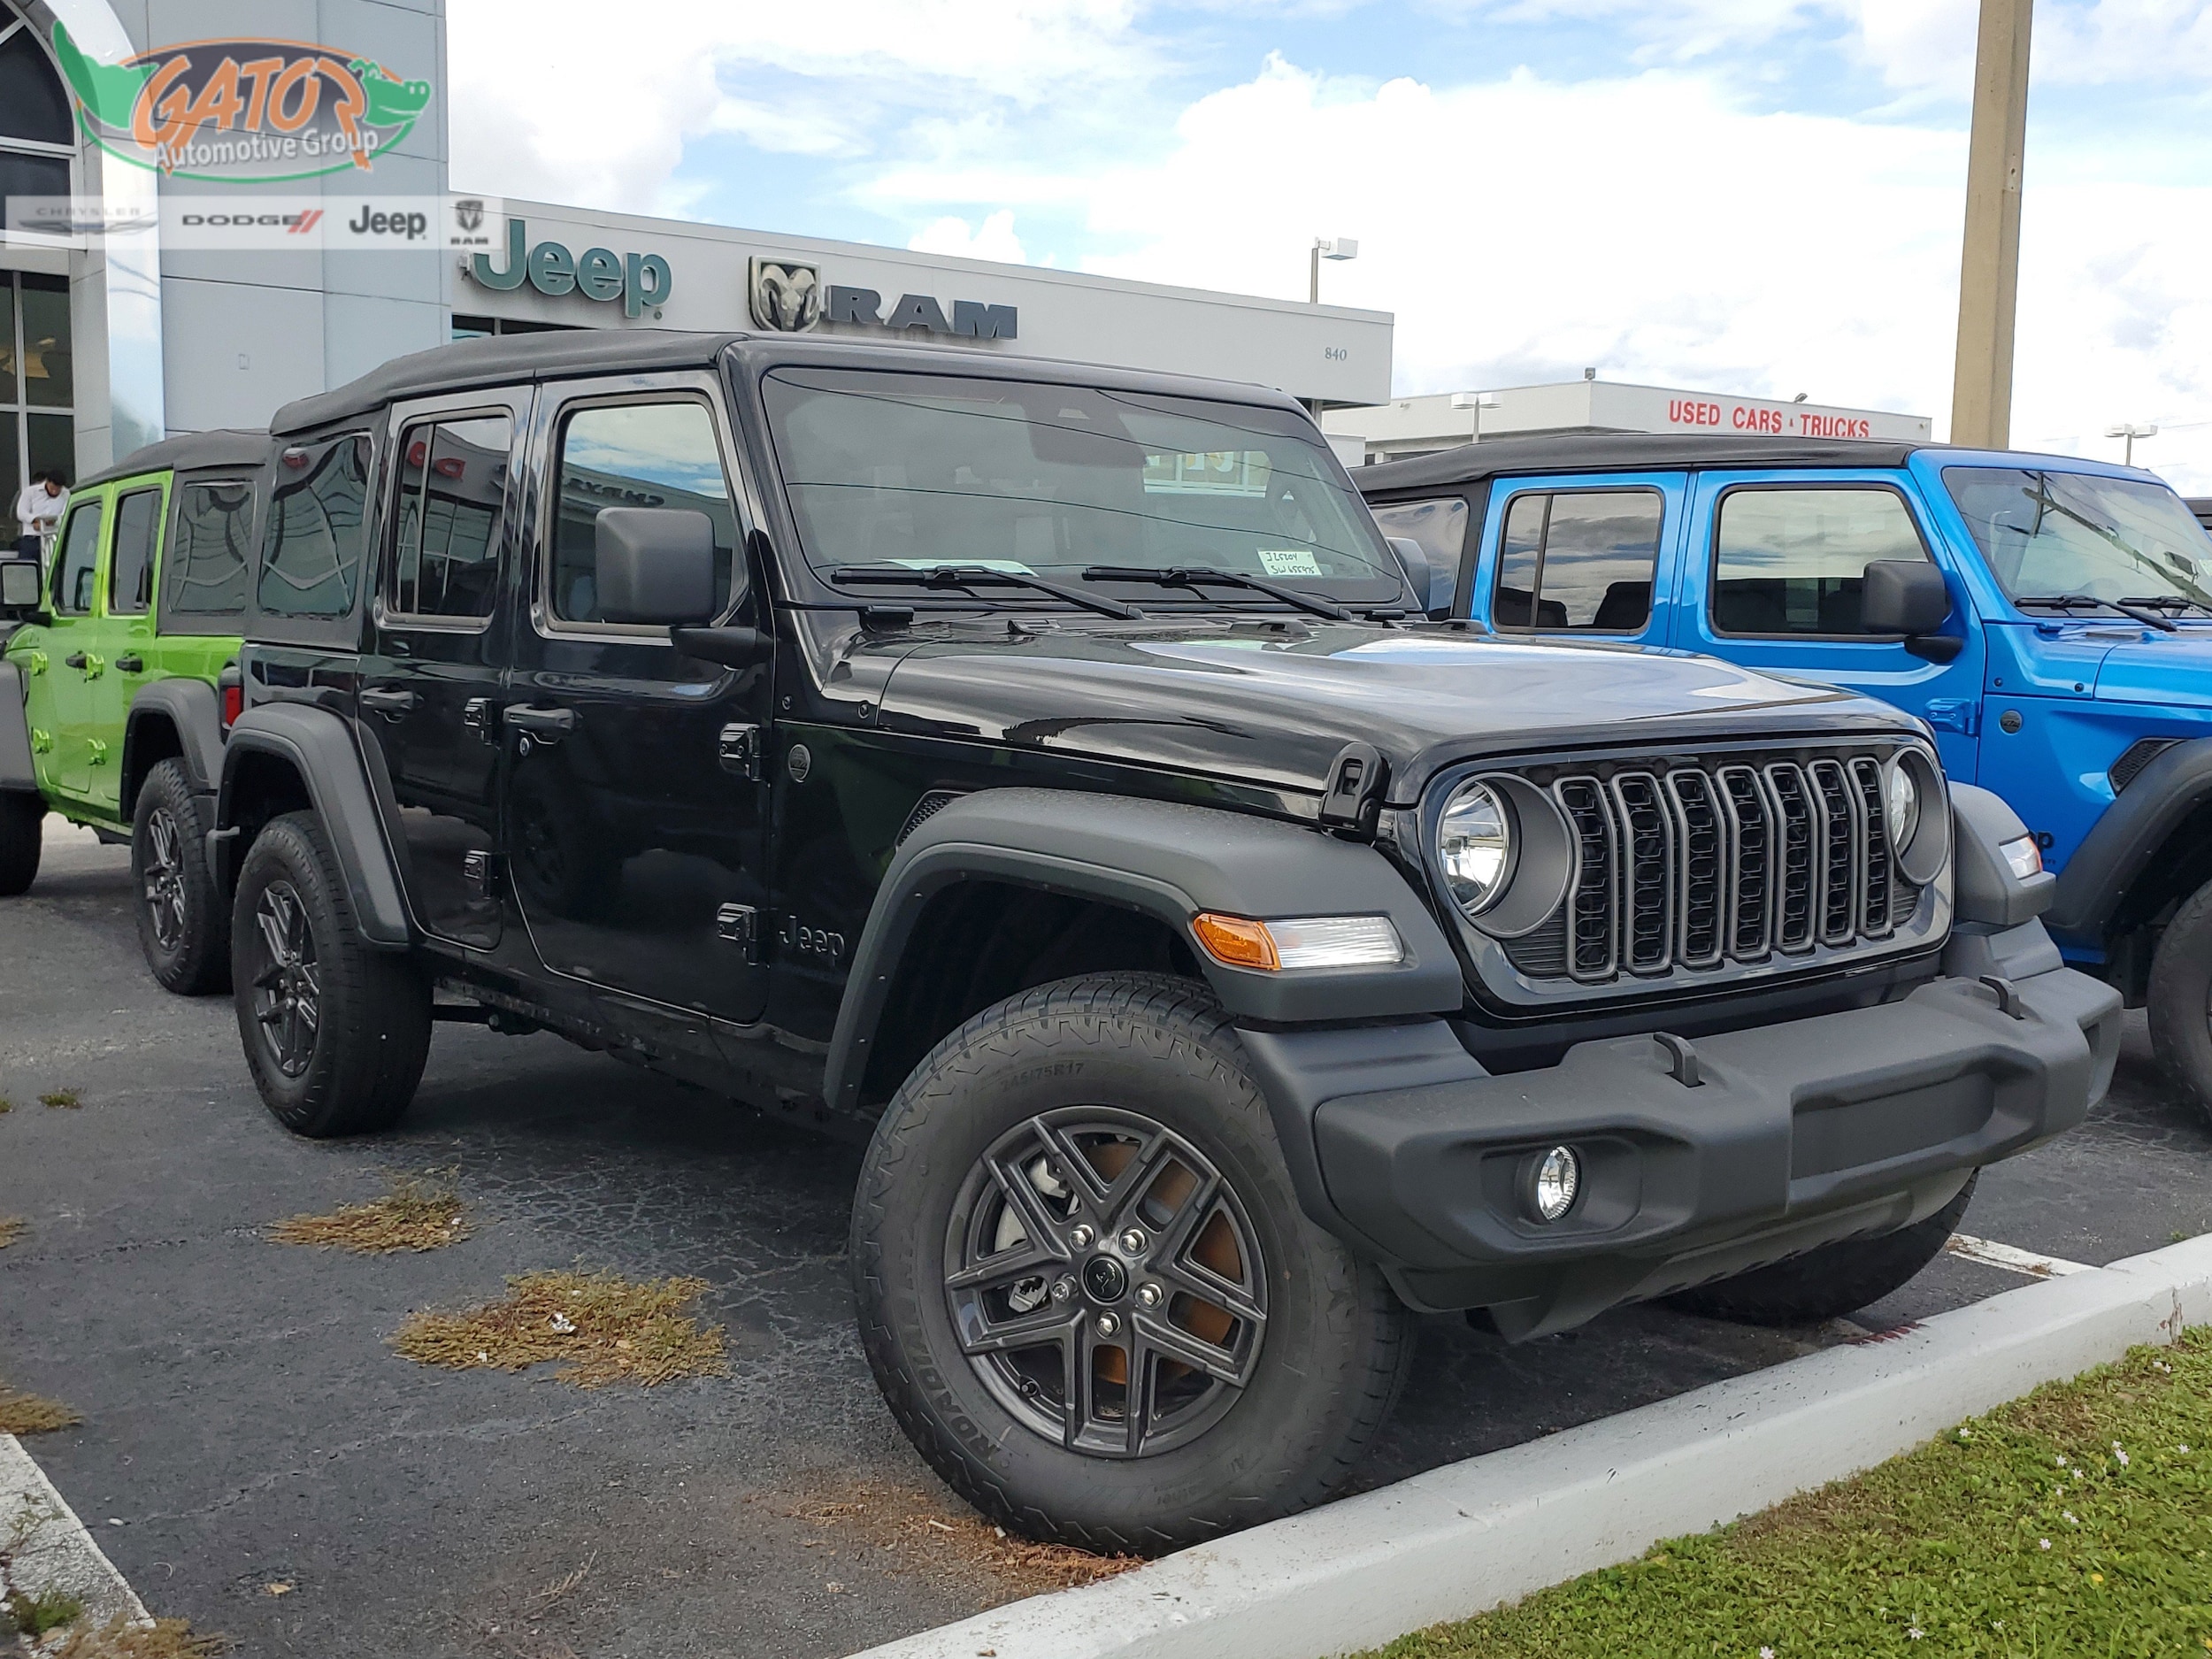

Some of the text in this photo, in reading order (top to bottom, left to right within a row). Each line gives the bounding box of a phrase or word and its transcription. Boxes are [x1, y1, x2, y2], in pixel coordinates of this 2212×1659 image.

[472, 219, 672, 319] Jeep
[825, 283, 1018, 340] RAM
[1324, 346, 1347, 361] 840
[1669, 400, 1870, 438] USED CARS TRUCKS
[779, 915, 846, 966] Jeep
